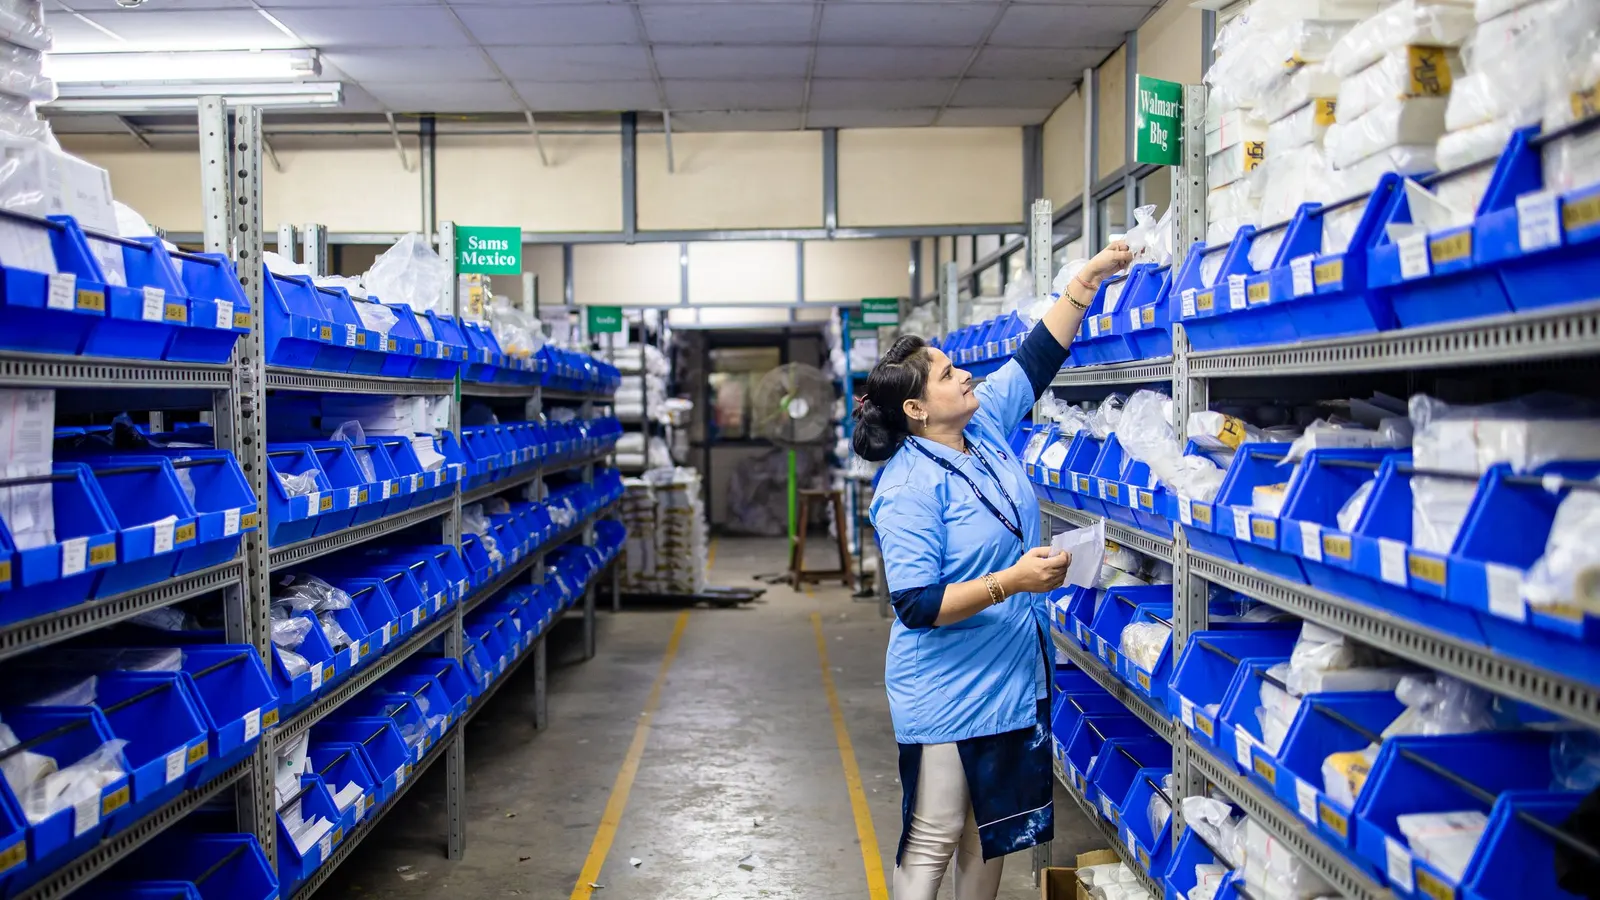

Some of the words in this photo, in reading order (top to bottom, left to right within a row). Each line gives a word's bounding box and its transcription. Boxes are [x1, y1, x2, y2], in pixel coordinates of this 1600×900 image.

[1140, 89, 1180, 118] Walmart
[1150, 121, 1168, 151] Bhg
[468, 235, 509, 250] Sams
[461, 251, 516, 266] Mexico
